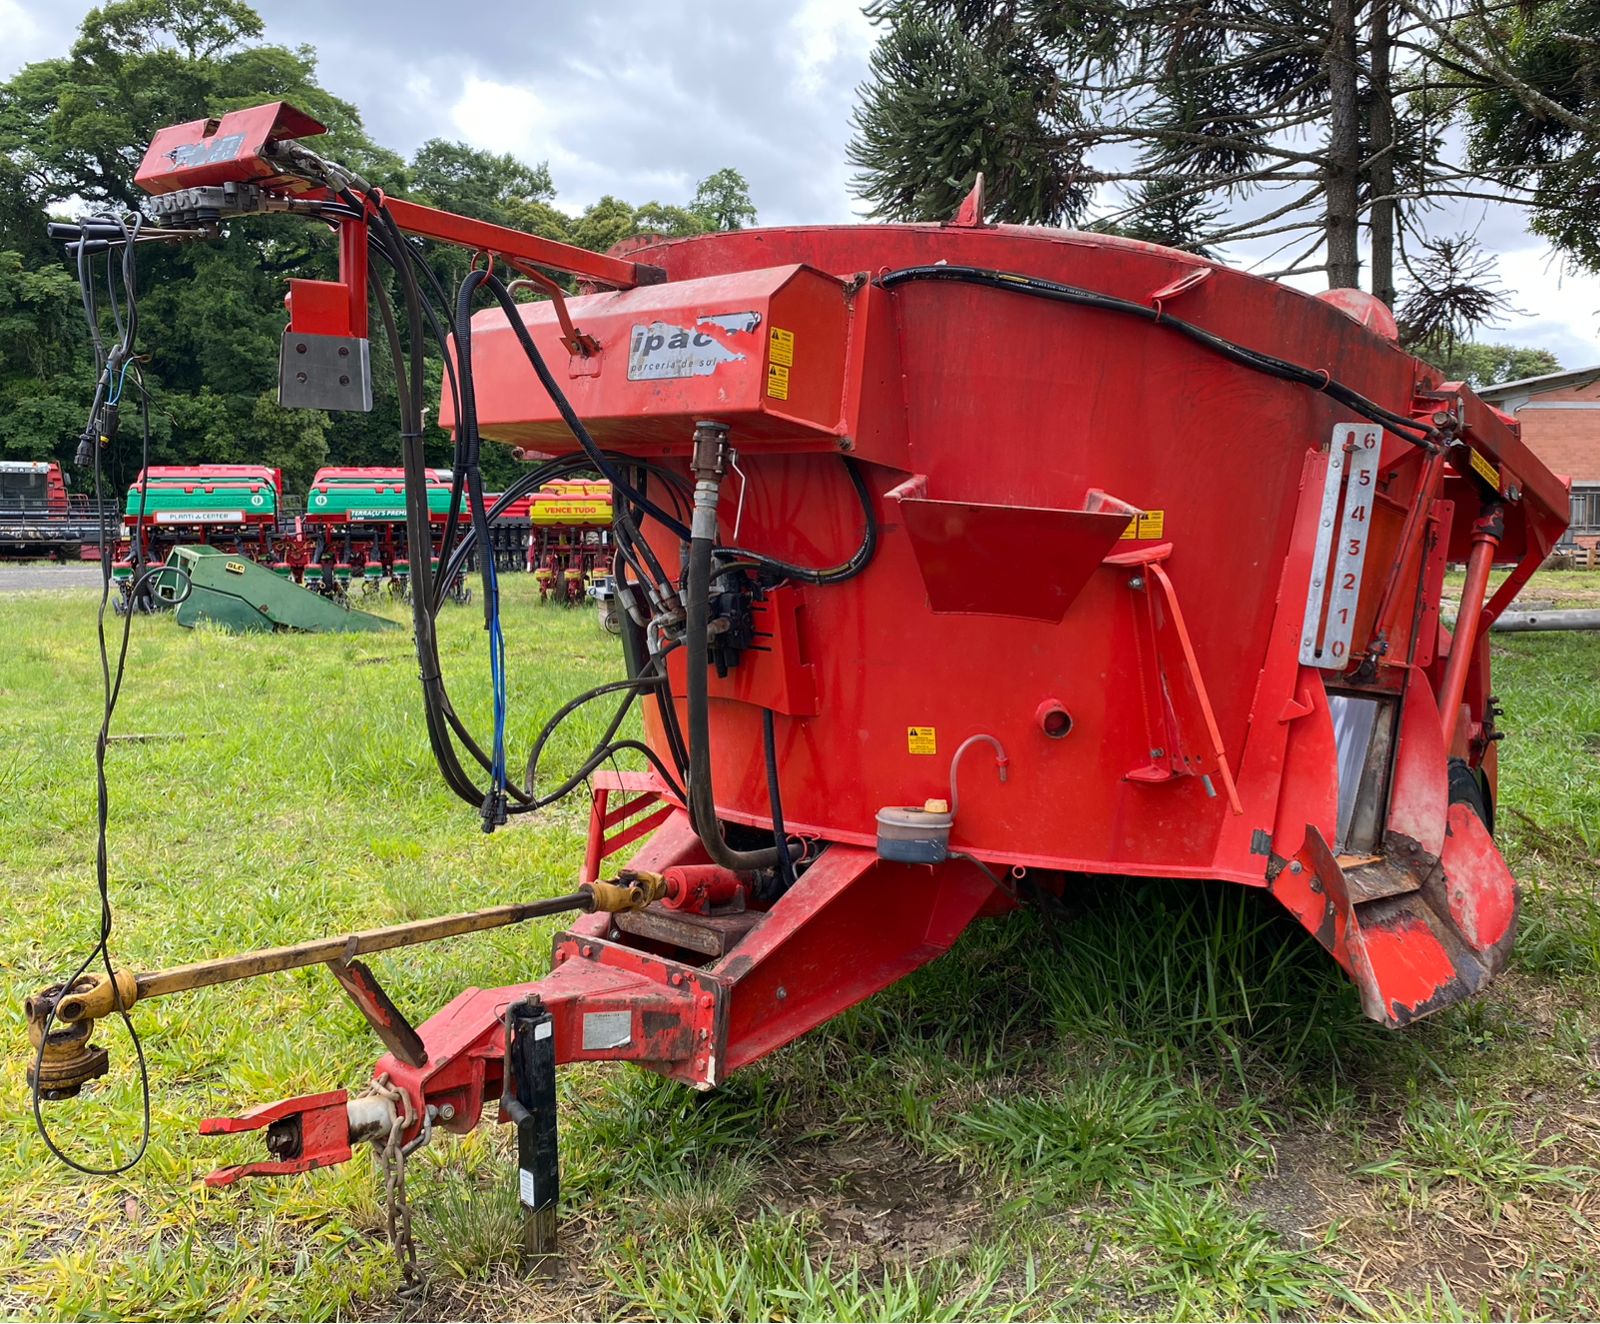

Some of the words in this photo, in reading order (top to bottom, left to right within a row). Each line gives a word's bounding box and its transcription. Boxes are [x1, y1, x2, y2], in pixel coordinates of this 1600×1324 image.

[1363, 432, 1377, 449] 6
[1359, 469, 1371, 486] 5
[1351, 505, 1366, 522] 4
[1347, 539, 1361, 556] 3
[1343, 573, 1356, 590] 2
[1337, 608, 1349, 625] 1
[1331, 640, 1345, 657] 0
